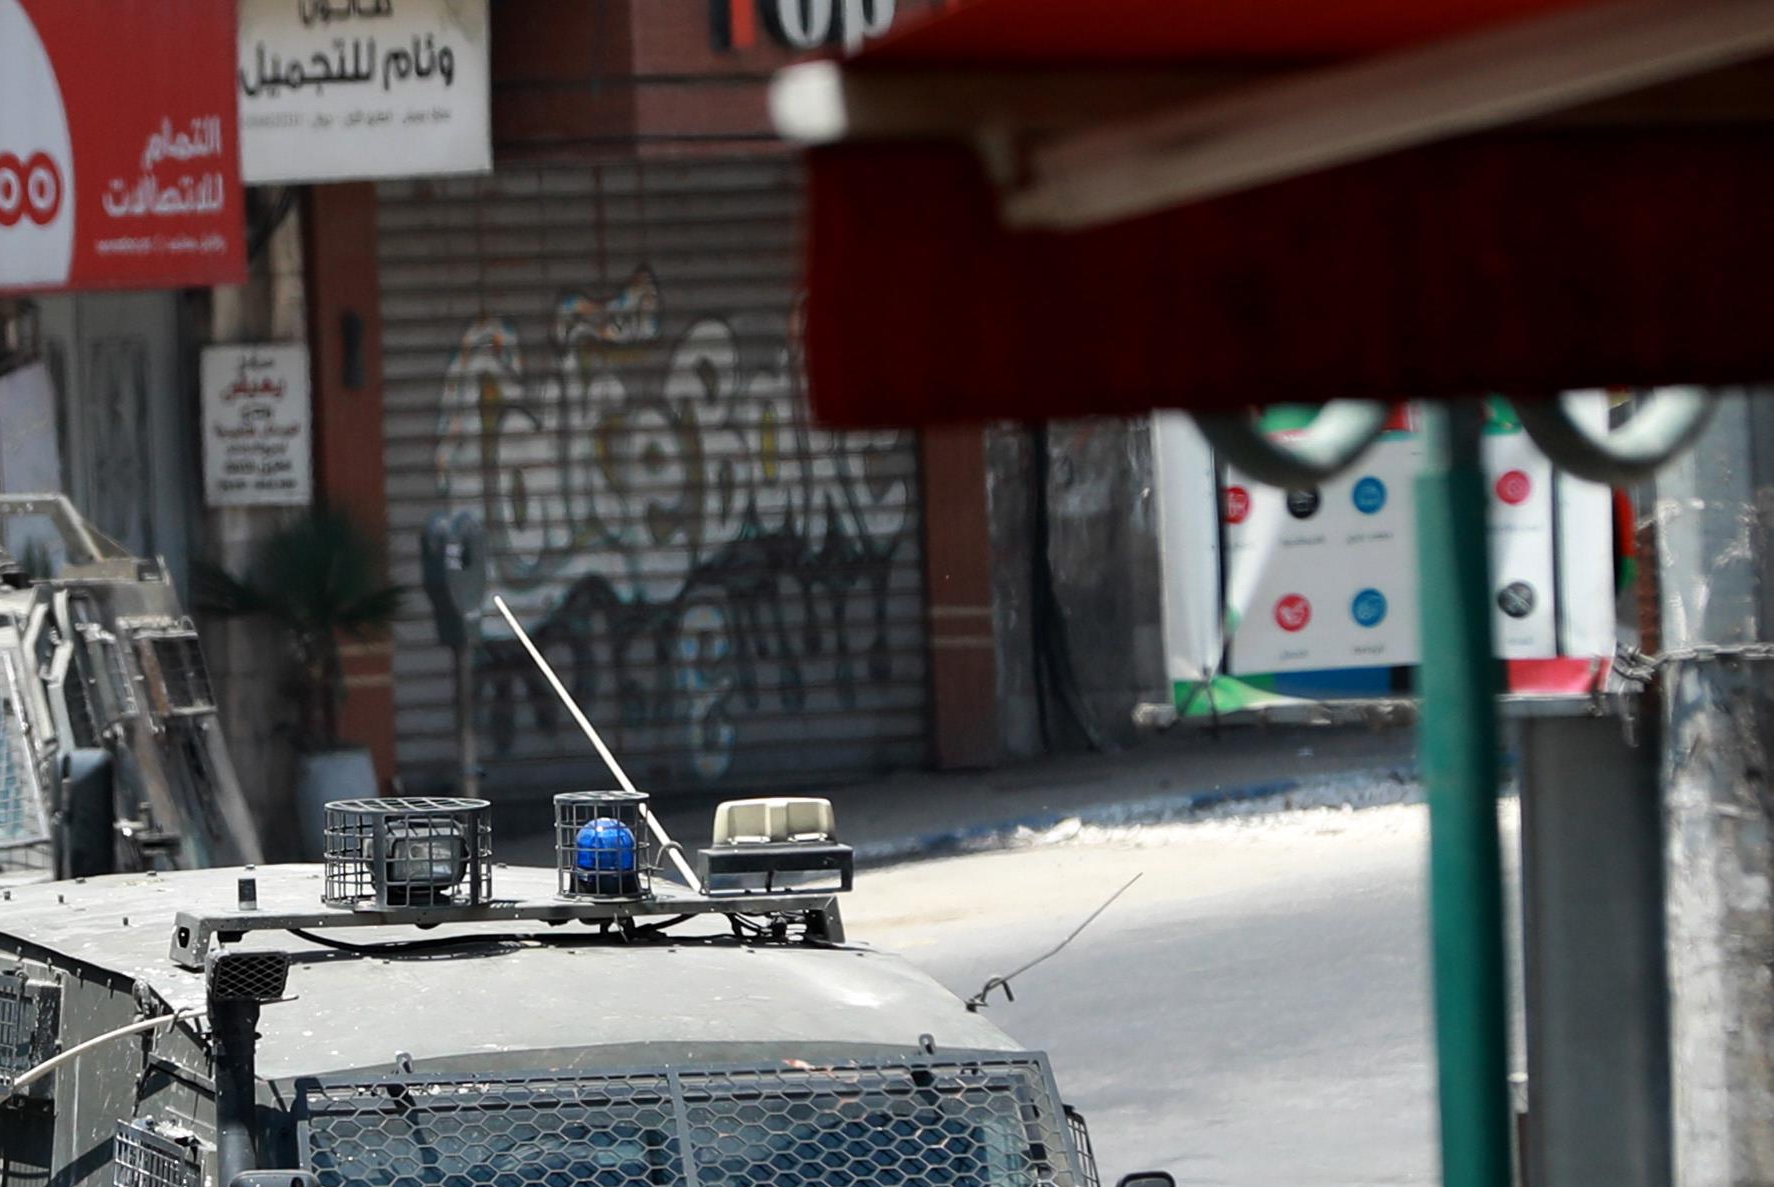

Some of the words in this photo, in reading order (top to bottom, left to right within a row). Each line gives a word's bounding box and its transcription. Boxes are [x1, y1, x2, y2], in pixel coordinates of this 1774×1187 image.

[239, 36, 376, 98] للتجميل
[141, 115, 223, 171] التمام
[101, 171, 224, 219] للاتصالات
